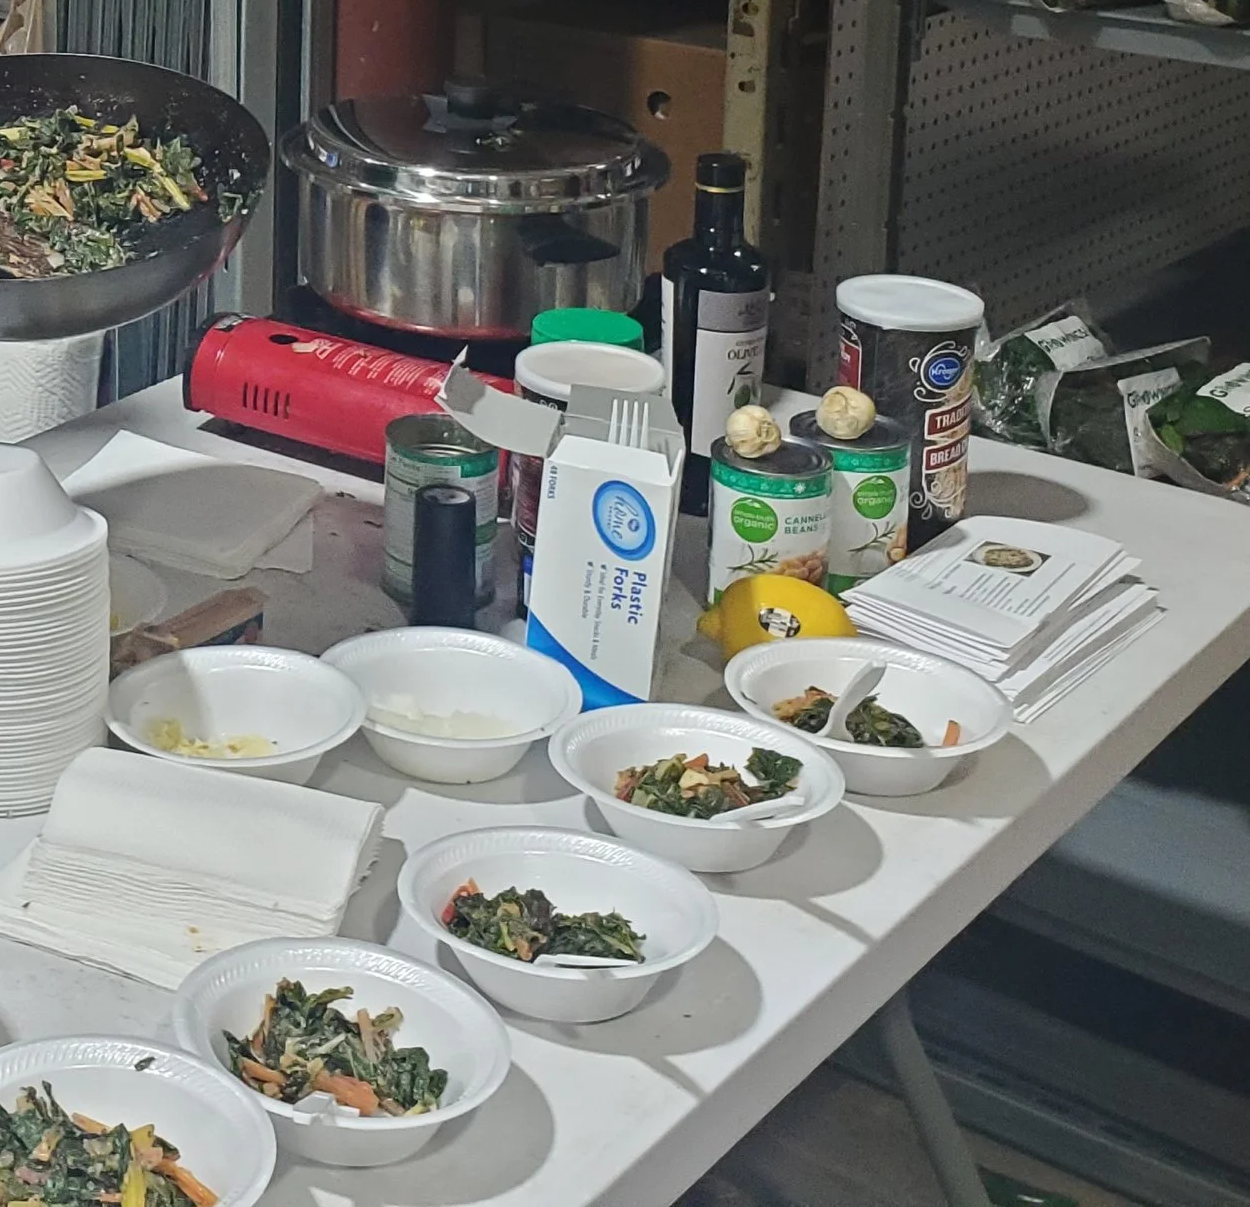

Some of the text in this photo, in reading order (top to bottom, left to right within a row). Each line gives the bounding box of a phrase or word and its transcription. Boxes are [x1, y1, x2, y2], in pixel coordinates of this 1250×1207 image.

[931, 363, 960, 380] Kroger
[547, 474, 558, 499] FORKS
[733, 515, 775, 532] organic
[610, 567, 629, 610] Forks
[627, 570, 648, 625] Plastic
